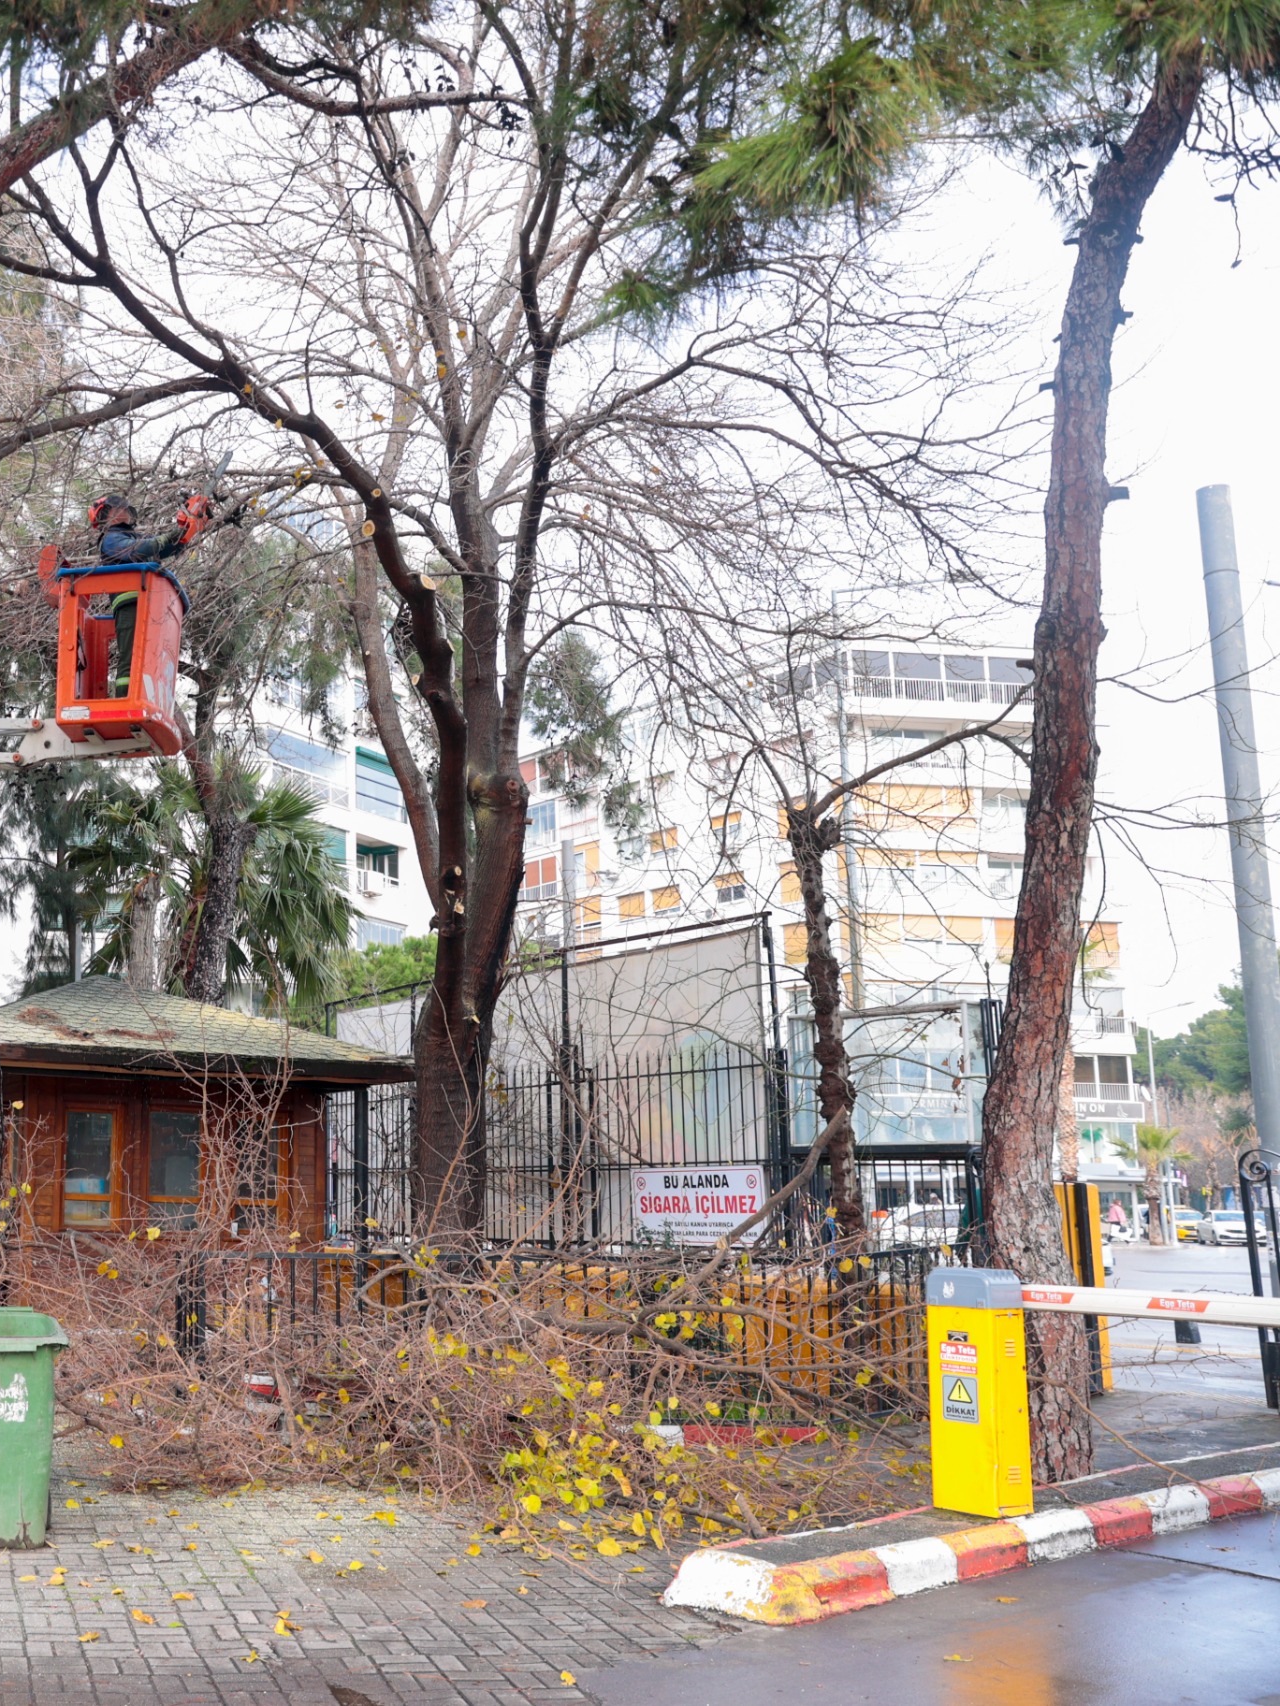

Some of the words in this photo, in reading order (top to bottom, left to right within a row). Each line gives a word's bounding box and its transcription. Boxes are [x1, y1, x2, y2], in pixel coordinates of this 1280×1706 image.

[663, 1175, 679, 1189] BU
[682, 1174, 730, 1189] ALANDA
[640, 1192, 691, 1214] SİGARA
[695, 1191, 758, 1219] İÇİLMEZ
[1030, 1291, 1044, 1301] Ege
[1046, 1292, 1062, 1301] Teta
[1159, 1299, 1174, 1308] Ege
[1176, 1299, 1195, 1309] Teta
[941, 1343, 956, 1354] Ege
[957, 1345, 976, 1355] Teta
[946, 1405, 976, 1417] DİKKAT
